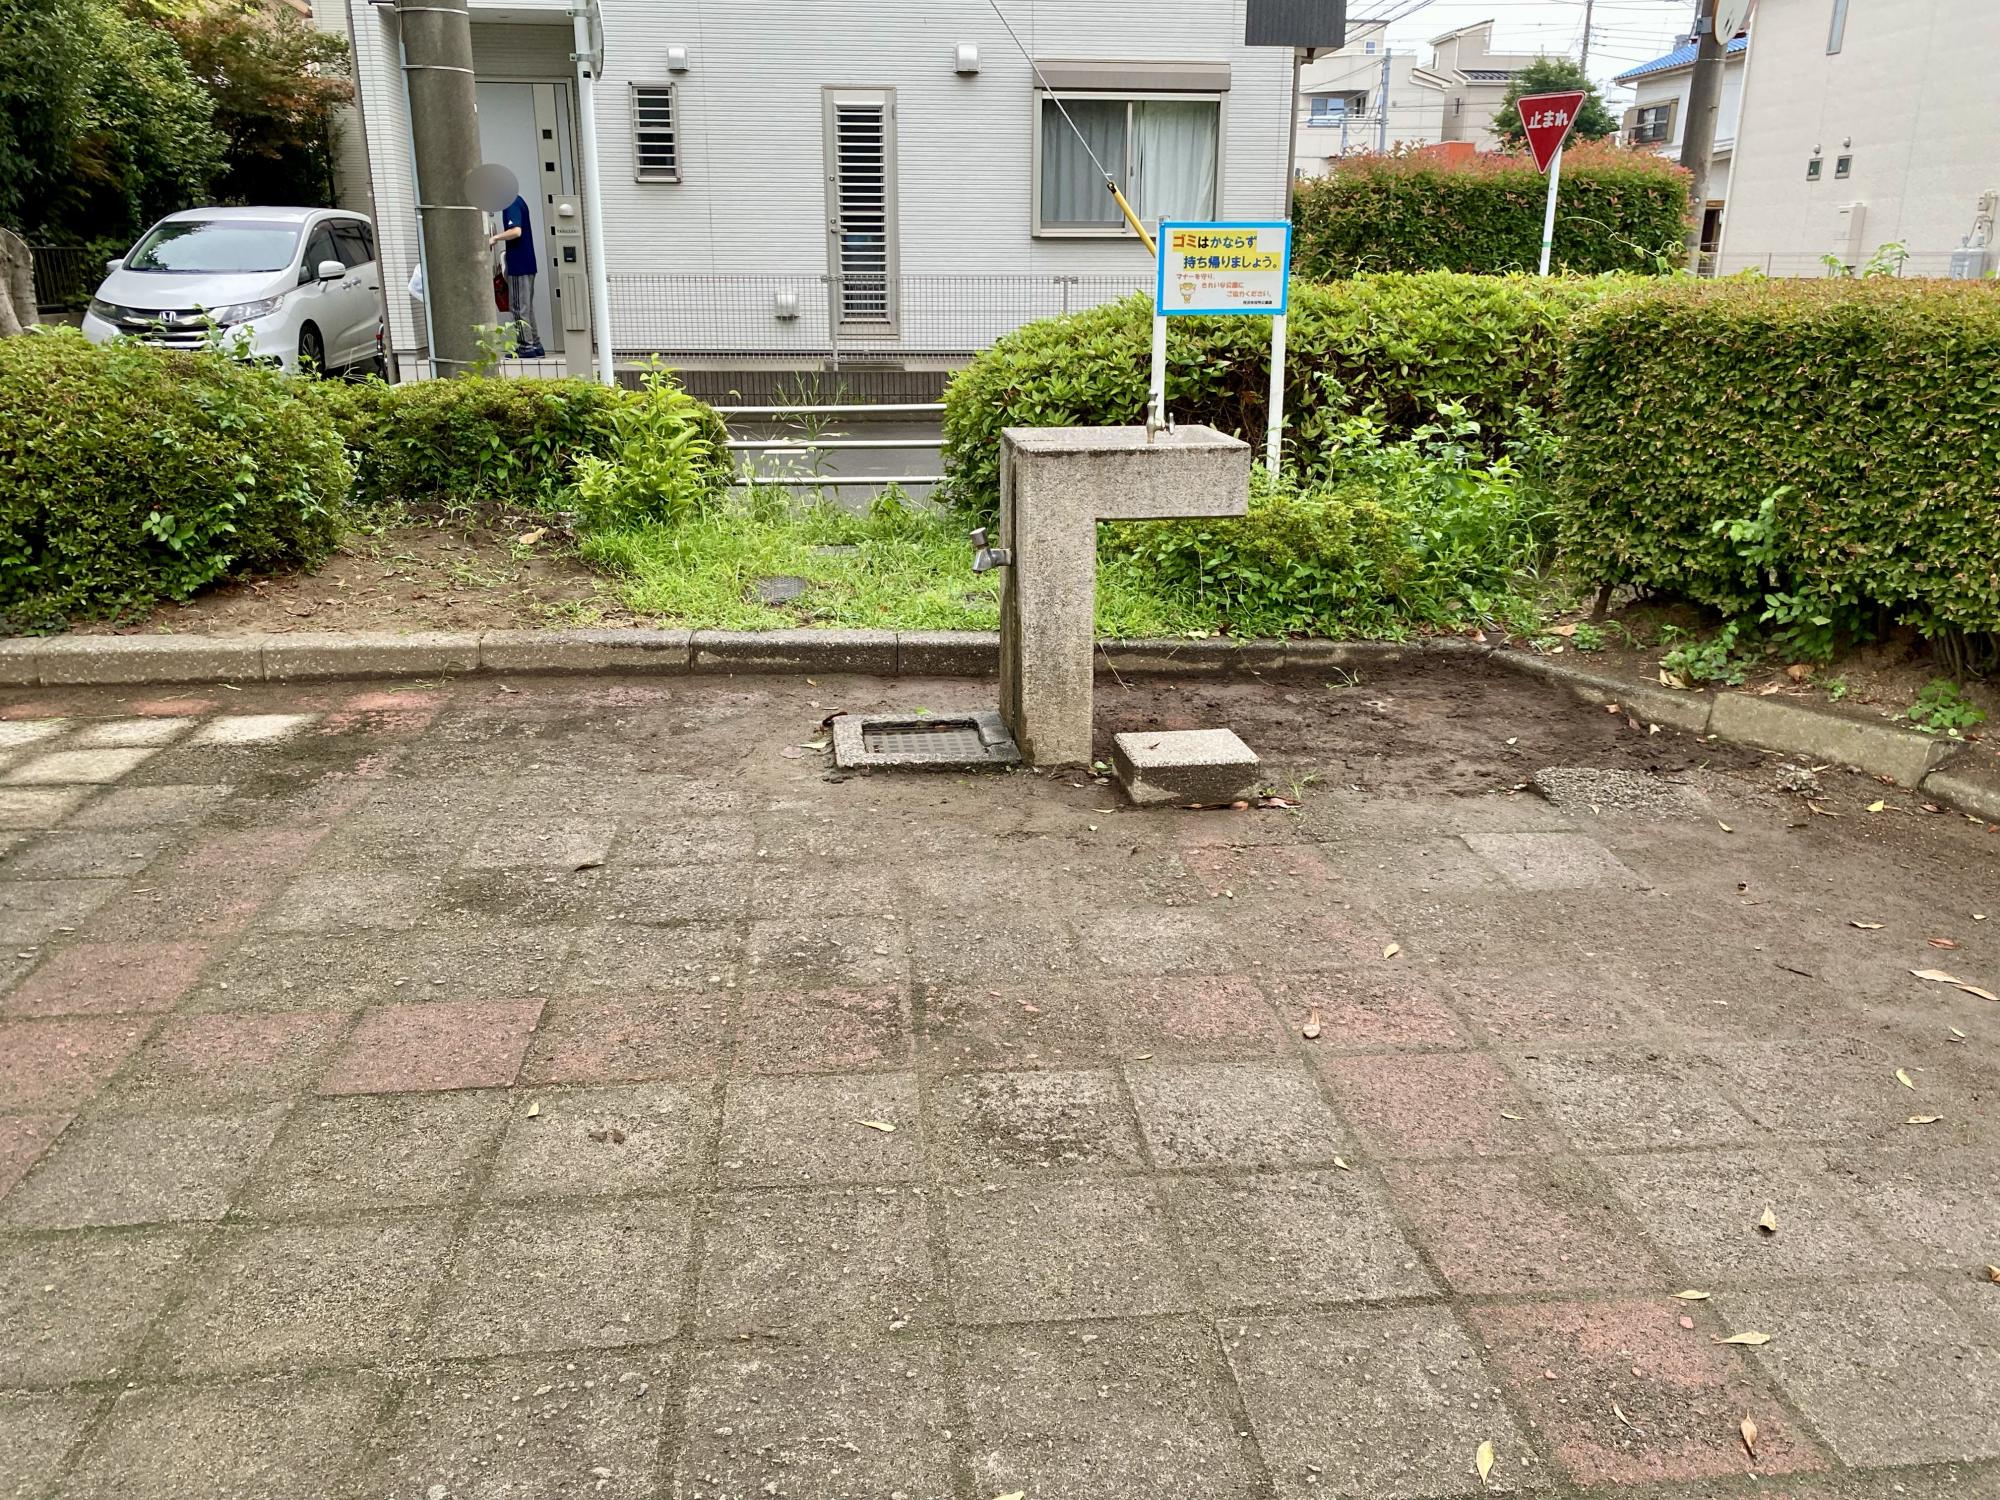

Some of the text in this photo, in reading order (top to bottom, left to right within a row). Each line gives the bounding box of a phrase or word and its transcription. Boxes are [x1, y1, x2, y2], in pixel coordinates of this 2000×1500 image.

[1527, 109, 1569, 129] 止まれ
[1172, 234, 1257, 249] ゴミはかならず
[1183, 255, 1278, 269] 持ち帰りましょう。
